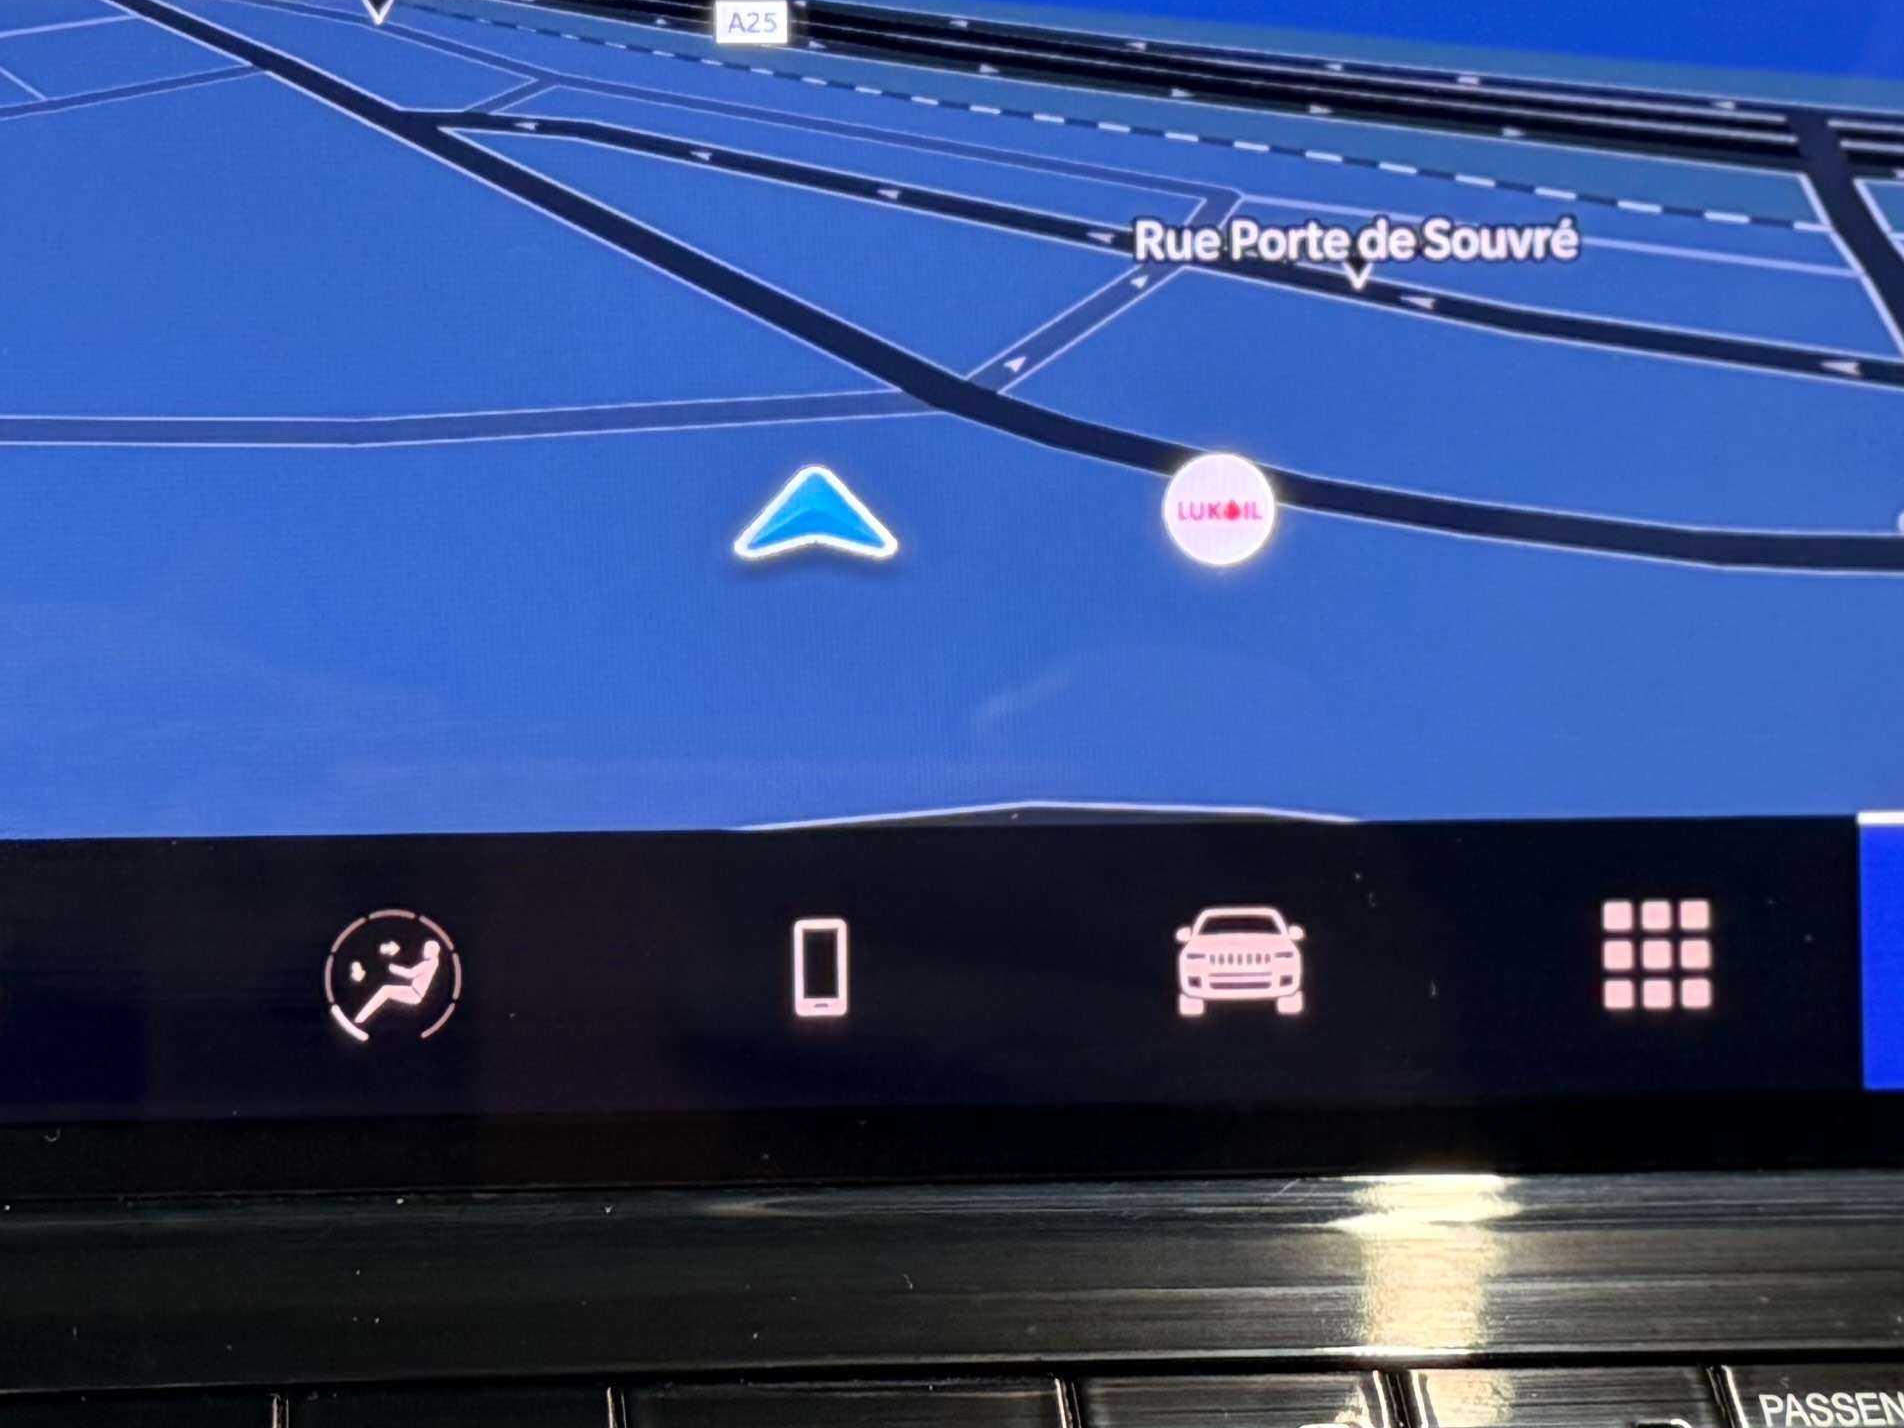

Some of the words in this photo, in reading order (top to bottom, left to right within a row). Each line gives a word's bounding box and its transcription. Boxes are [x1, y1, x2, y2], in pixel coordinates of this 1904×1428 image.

[727, 10, 778, 36] A25
[1133, 220, 1222, 262] Rue
[1230, 220, 1351, 262] Porte
[1357, 218, 1414, 262] de
[1422, 218, 1580, 262] Souvré
